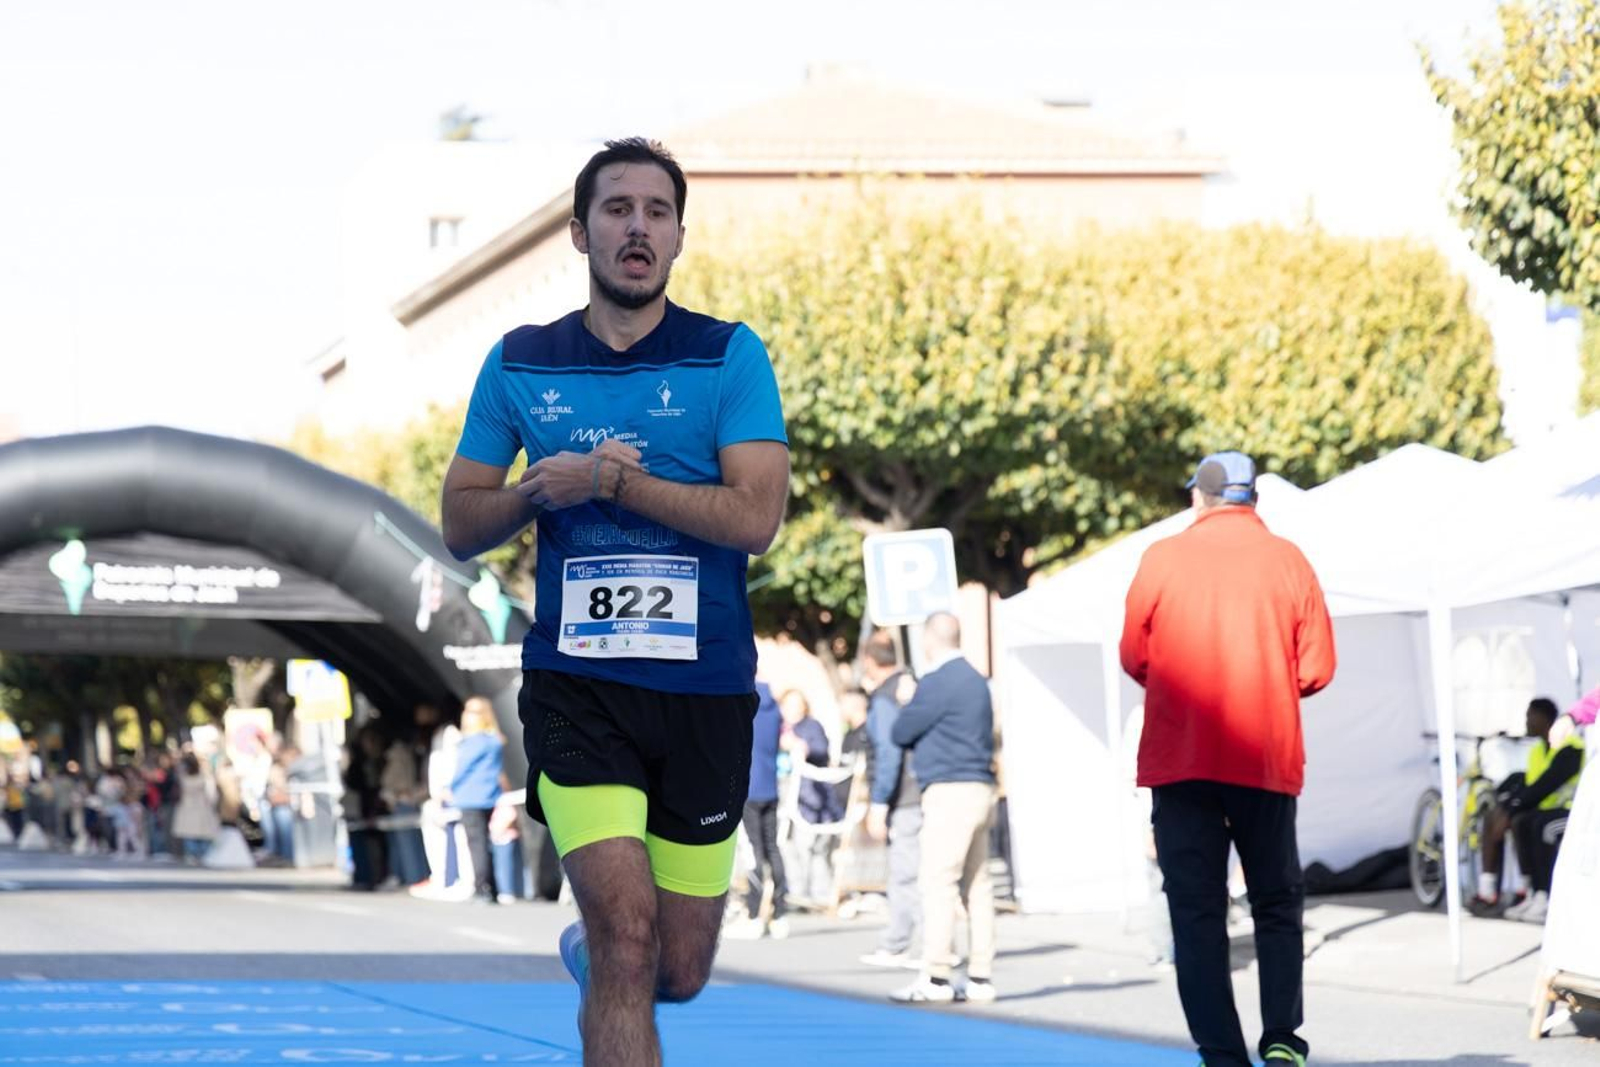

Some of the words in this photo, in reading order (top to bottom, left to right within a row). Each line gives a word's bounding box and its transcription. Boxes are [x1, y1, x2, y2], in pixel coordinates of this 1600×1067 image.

[613, 432, 638, 440] MEDIA
[883, 543, 937, 615] P
[589, 585, 673, 620] 822
[611, 622, 650, 631] ANTONIO
